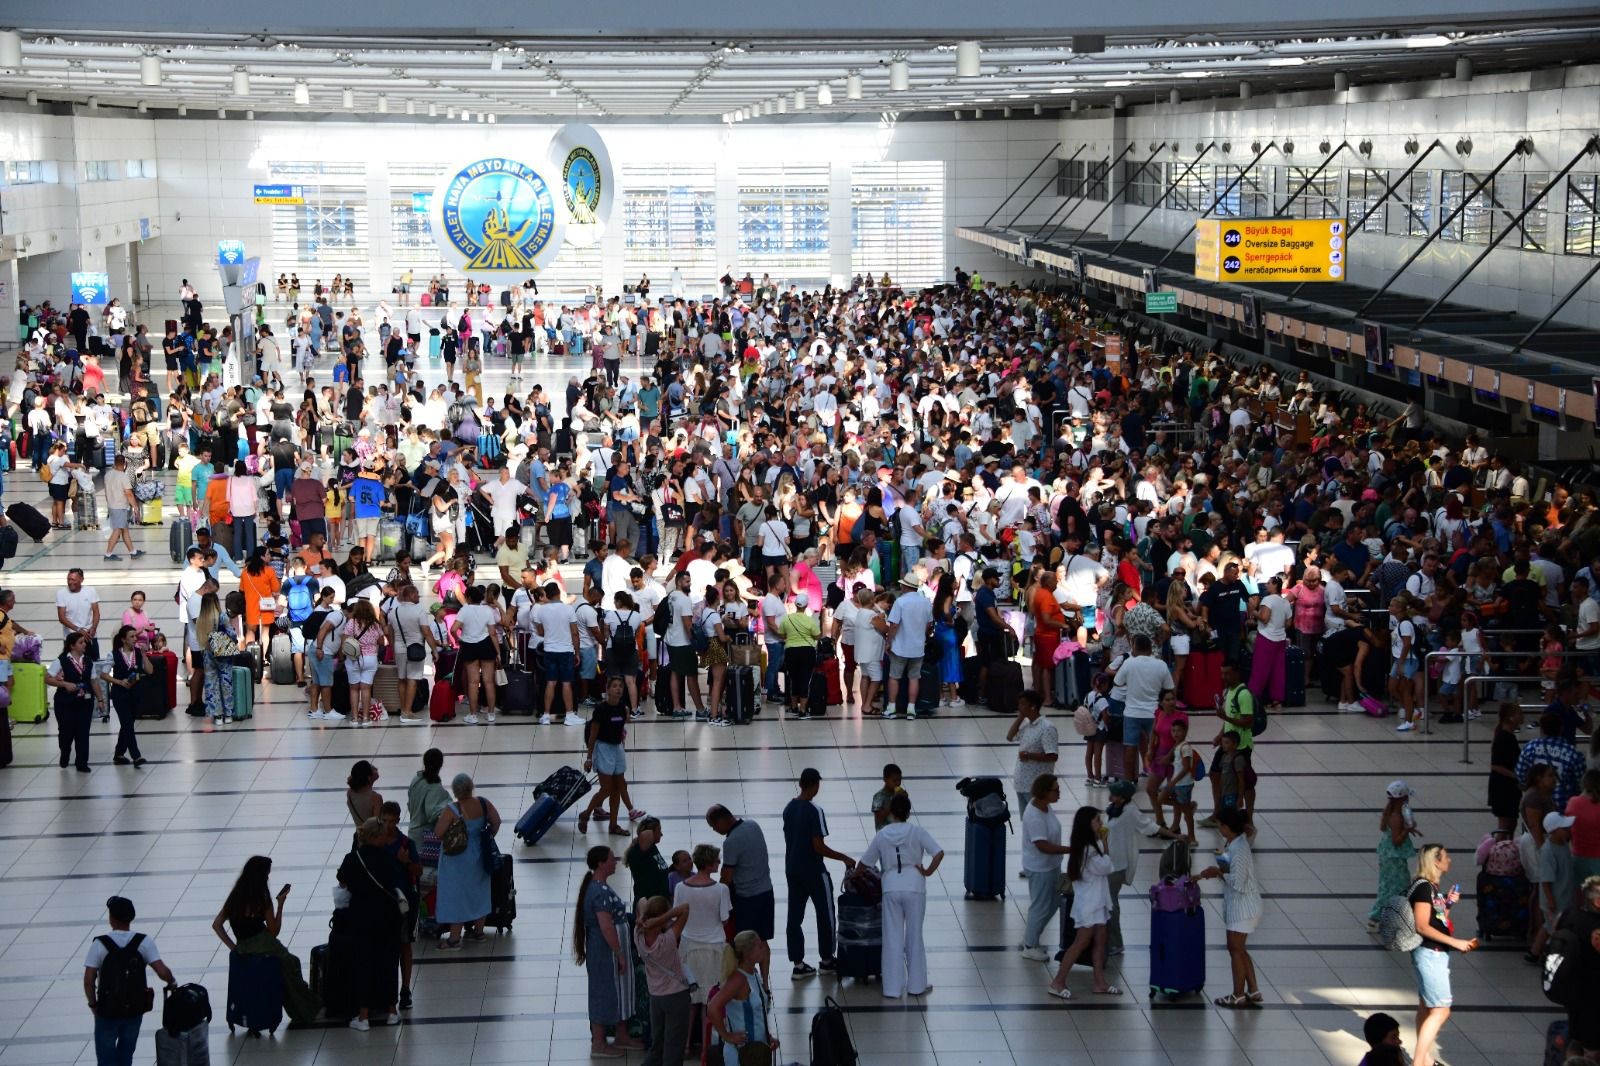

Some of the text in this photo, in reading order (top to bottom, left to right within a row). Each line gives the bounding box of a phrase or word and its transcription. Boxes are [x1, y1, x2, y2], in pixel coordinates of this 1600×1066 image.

[466, 159, 545, 193] MEYDANLARI
[447, 175, 470, 207] HAVA
[447, 209, 475, 254] DEVLET
[1226, 225, 1293, 243] 241 Büyük Bagaj
[1245, 239, 1314, 250] Oversize Baggage
[1225, 252, 1293, 269] 242 Sperrgepäck
[1244, 265, 1322, 275] негабаритный багаж
